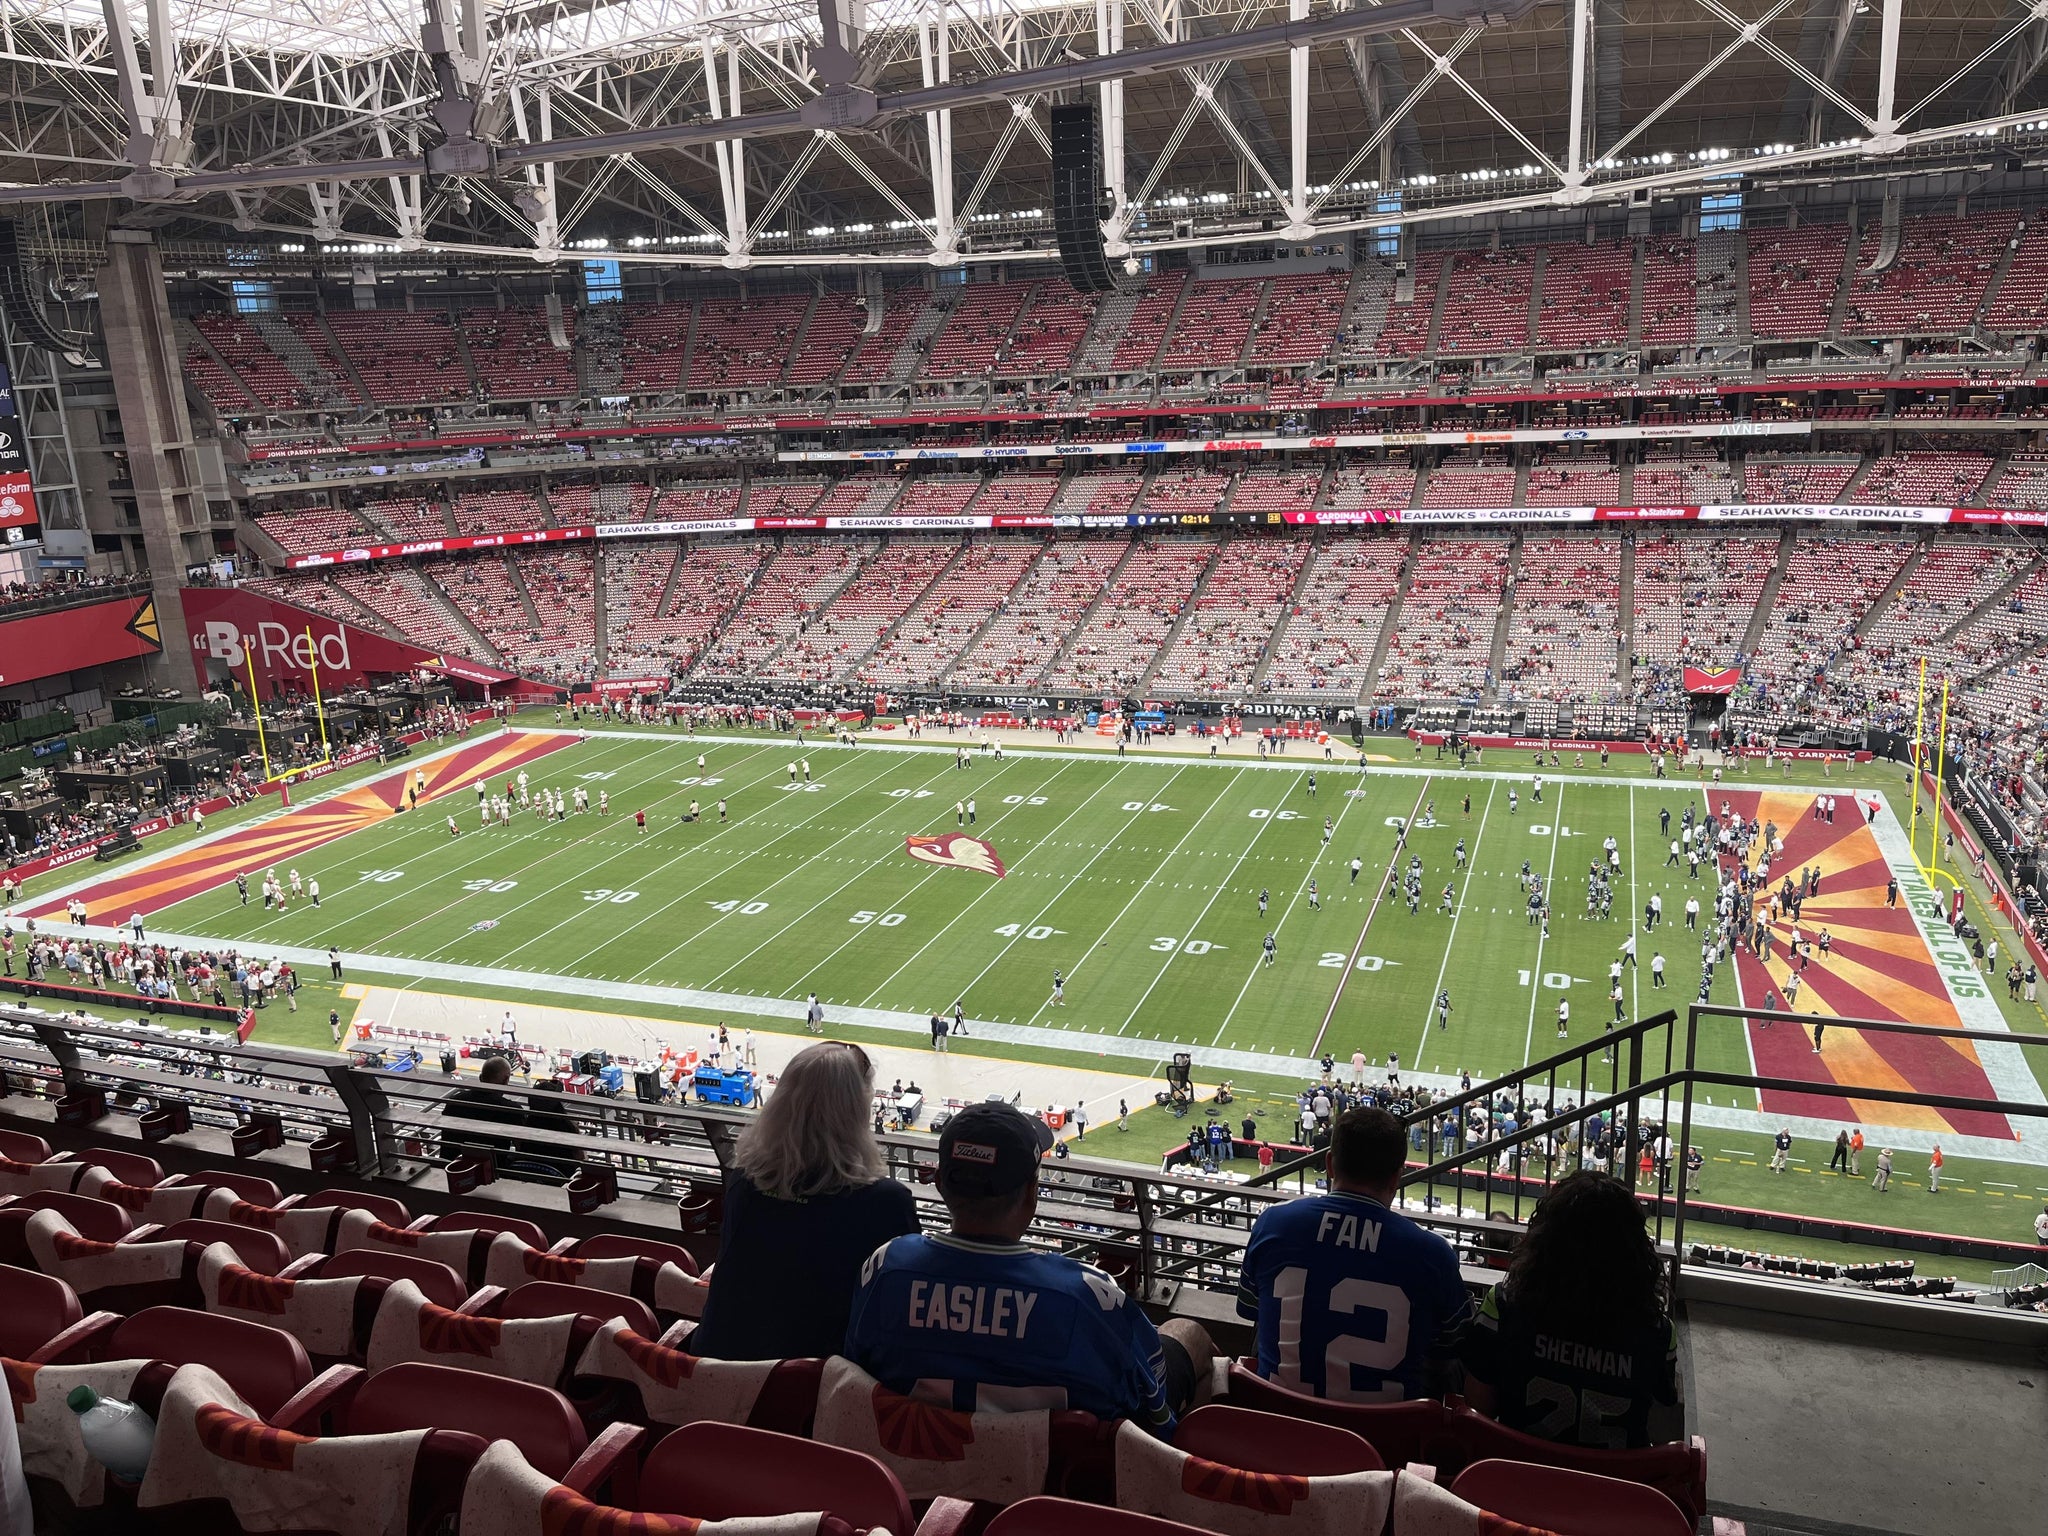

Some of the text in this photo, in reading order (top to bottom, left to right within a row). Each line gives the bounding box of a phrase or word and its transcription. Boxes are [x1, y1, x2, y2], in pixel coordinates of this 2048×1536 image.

[1634, 389, 1663, 397] (NIGHT
[1664, 388, 1693, 396] TRAIN)
[1695, 387, 1718, 395] LANE
[1719, 423, 1773, 435] AVNET
[1403, 434, 1427, 442] RIVER
[287, 449, 316, 457] (PADDY)
[317, 447, 350, 455] DRISCOLL
[995, 448, 1027, 456] HYUNDAI
[1055, 446, 1091, 454] Spectrum
[1126, 444, 1143, 452] BUD
[0, 483, 30, 495] eFarm
[1082, 515, 1128, 523] SEAHAWKS
[1180, 514, 1210, 524] 42:14
[1316, 512, 1367, 520] CARDINALS
[1402, 510, 1476, 520] EAHAWKS
[1489, 510, 1571, 519] CARDINALS
[1719, 507, 1814, 516] SEAHAWKS
[1829, 508, 1923, 518] CARDINALS
[597, 525, 660, 535] EAHAWKS
[671, 521, 737, 531] CARDINALS
[912, 518, 974, 526] CARDINALS
[473, 538, 495, 546] GAMES
[295, 557, 335, 567] SEASON
[258, 622, 351, 670] Red
[602, 680, 658, 690] RIVALRIES
[1220, 703, 1317, 715] CRDINAS
[1798, 751, 1848, 760] CARDNAL
[303, 748, 379, 778] ARIZON CARDINAL
[238, 786, 350, 828] STOP HATE
[48, 844, 98, 867] ARIZONA
[358, 869, 405, 883] 10
[461, 879, 519, 893] 20
[583, 889, 641, 904] 30
[711, 900, 770, 915] 40
[848, 910, 907, 927] 50
[992, 923, 1055, 940] 40
[1920, 920, 1958, 947] ALL
[1149, 936, 1213, 955] 30
[1317, 952, 1385, 971] 20
[1936, 951, 1972, 972] OF
[1517, 969, 1572, 990] 10
[1947, 975, 1985, 999] US
[1050, 1115, 1058, 1125] G
[1212, 1131, 1220, 1139] 12
[1639, 1132, 1648, 1141] 12
[954, 1144, 994, 1160] Titleist
[1316, 1211, 1383, 1253] FAN
[908, 1279, 1038, 1339] EASLEY
[1269, 1266, 1411, 1405] 12
[1534, 1332, 1633, 1380] SHERMAN
[1525, 1375, 1633, 1450] 25
